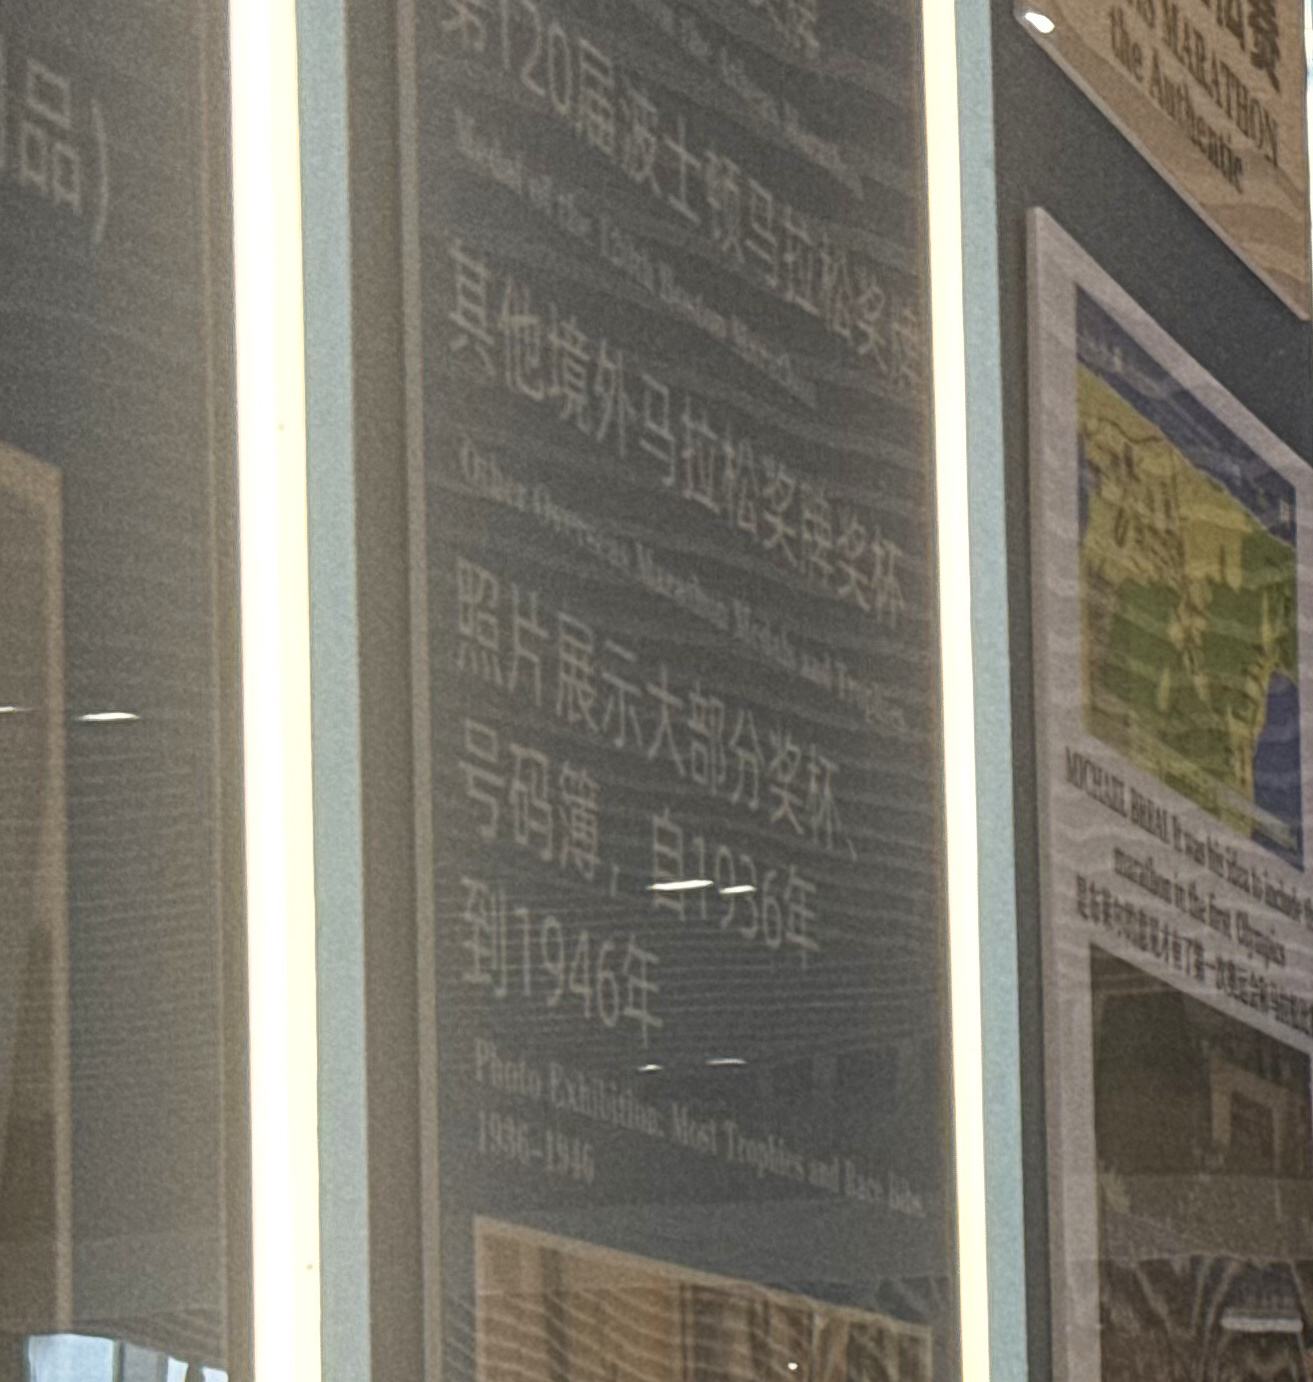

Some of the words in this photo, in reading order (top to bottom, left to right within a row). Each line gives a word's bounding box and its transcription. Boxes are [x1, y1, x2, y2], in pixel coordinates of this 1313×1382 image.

[450, 237, 900, 628] 其他境外马拉松奖牌奖杯
[460, 877, 662, 1048] 到1946年
[473, 1040, 542, 1097] Photo
